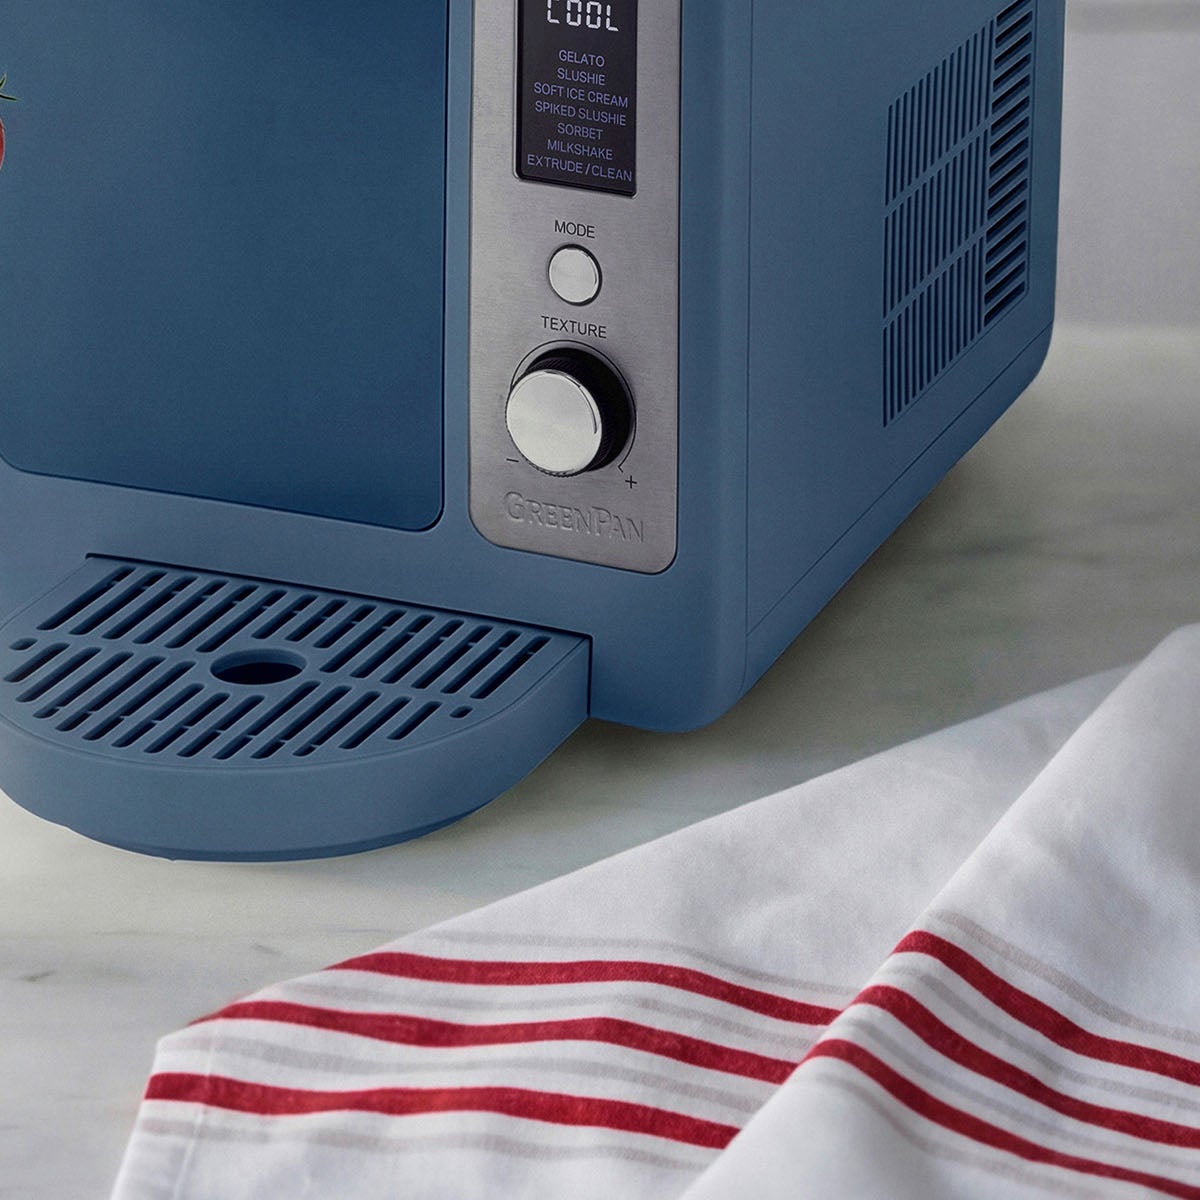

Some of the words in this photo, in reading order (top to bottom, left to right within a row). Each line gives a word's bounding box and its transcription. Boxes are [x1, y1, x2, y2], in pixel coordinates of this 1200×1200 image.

[558, 49, 605, 68] GELATO
[557, 67, 606, 86] SLUSHIE
[533, 82, 563, 98] SOFT
[566, 87, 585, 102] ICE
[587, 90, 629, 109] CREAM
[535, 101, 576, 118] SPIKED
[578, 108, 627, 127] SLUSHIE
[557, 122, 604, 141] SORBET
[547, 139, 613, 161] MILKSHAKE
[554, 220, 596, 239] MODE
[541, 315, 608, 339] TEXTURE
